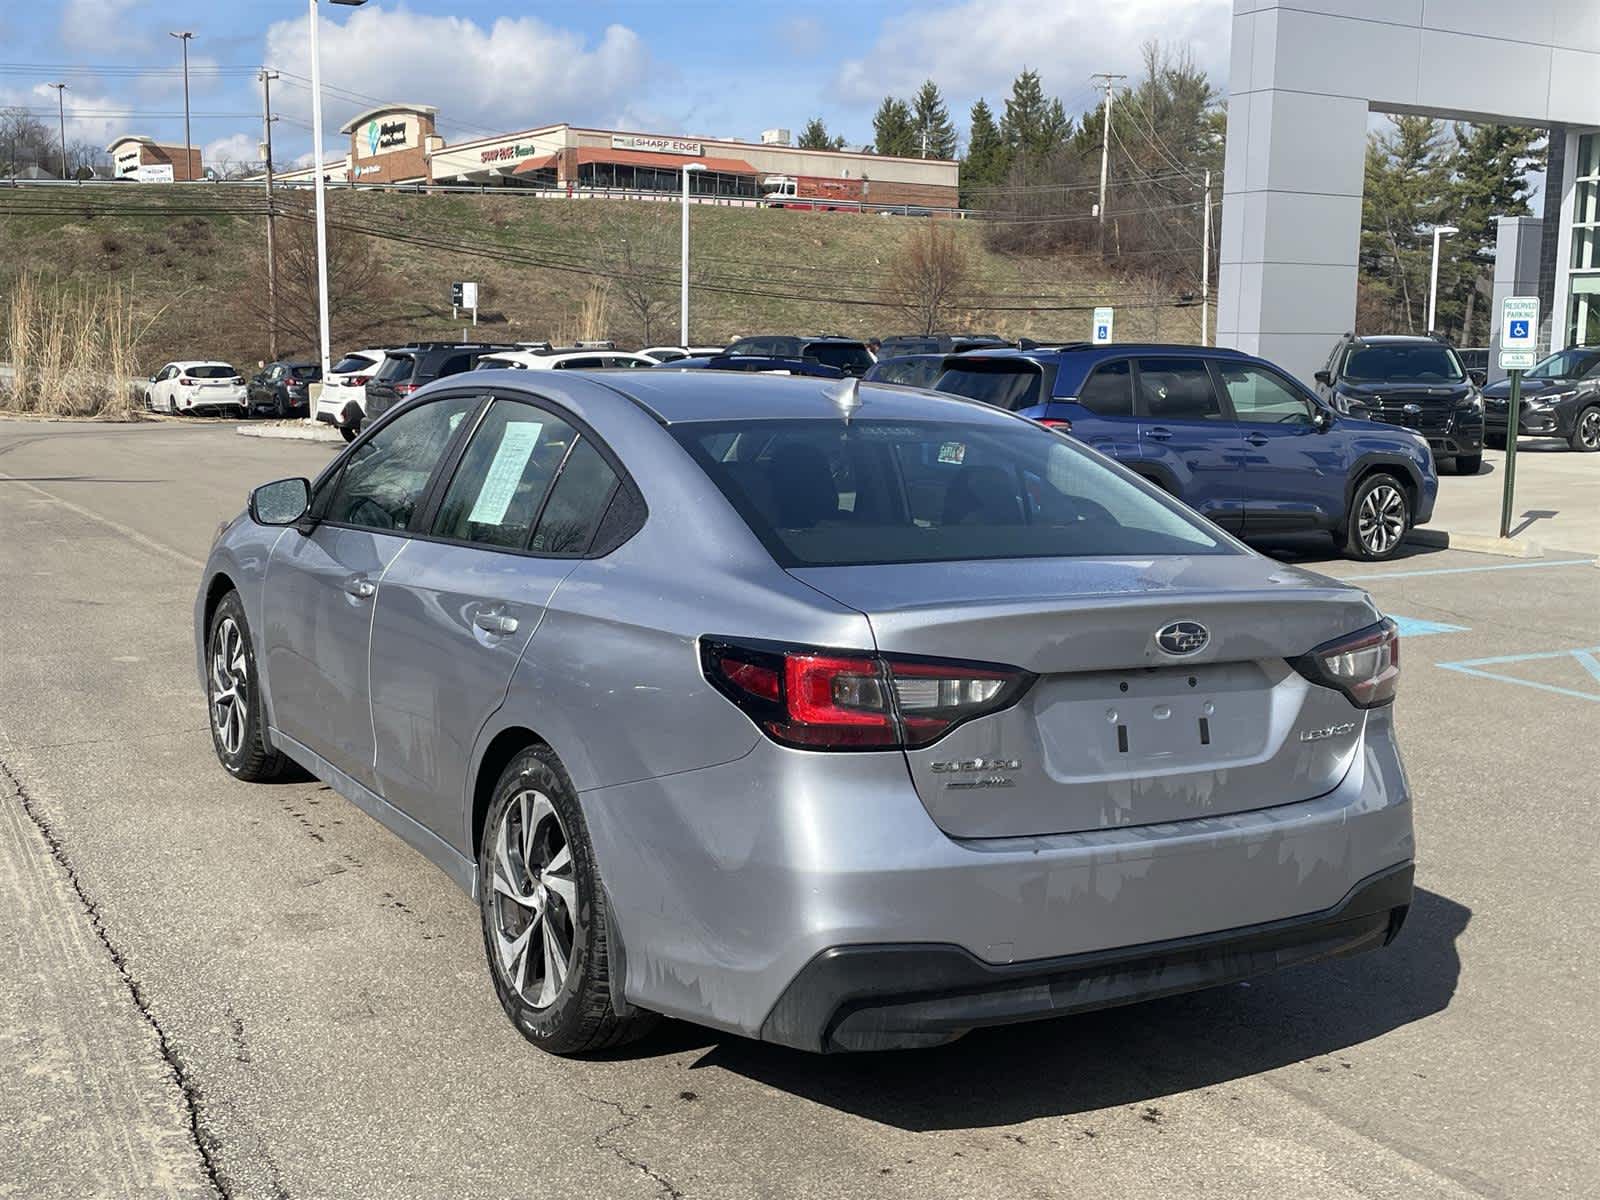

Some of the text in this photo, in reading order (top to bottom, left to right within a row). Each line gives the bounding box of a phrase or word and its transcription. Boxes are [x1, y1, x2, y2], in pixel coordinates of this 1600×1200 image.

[636, 139, 669, 149] SHARP
[673, 142, 698, 152] EDGE
[1504, 302, 1536, 310] RESERVED
